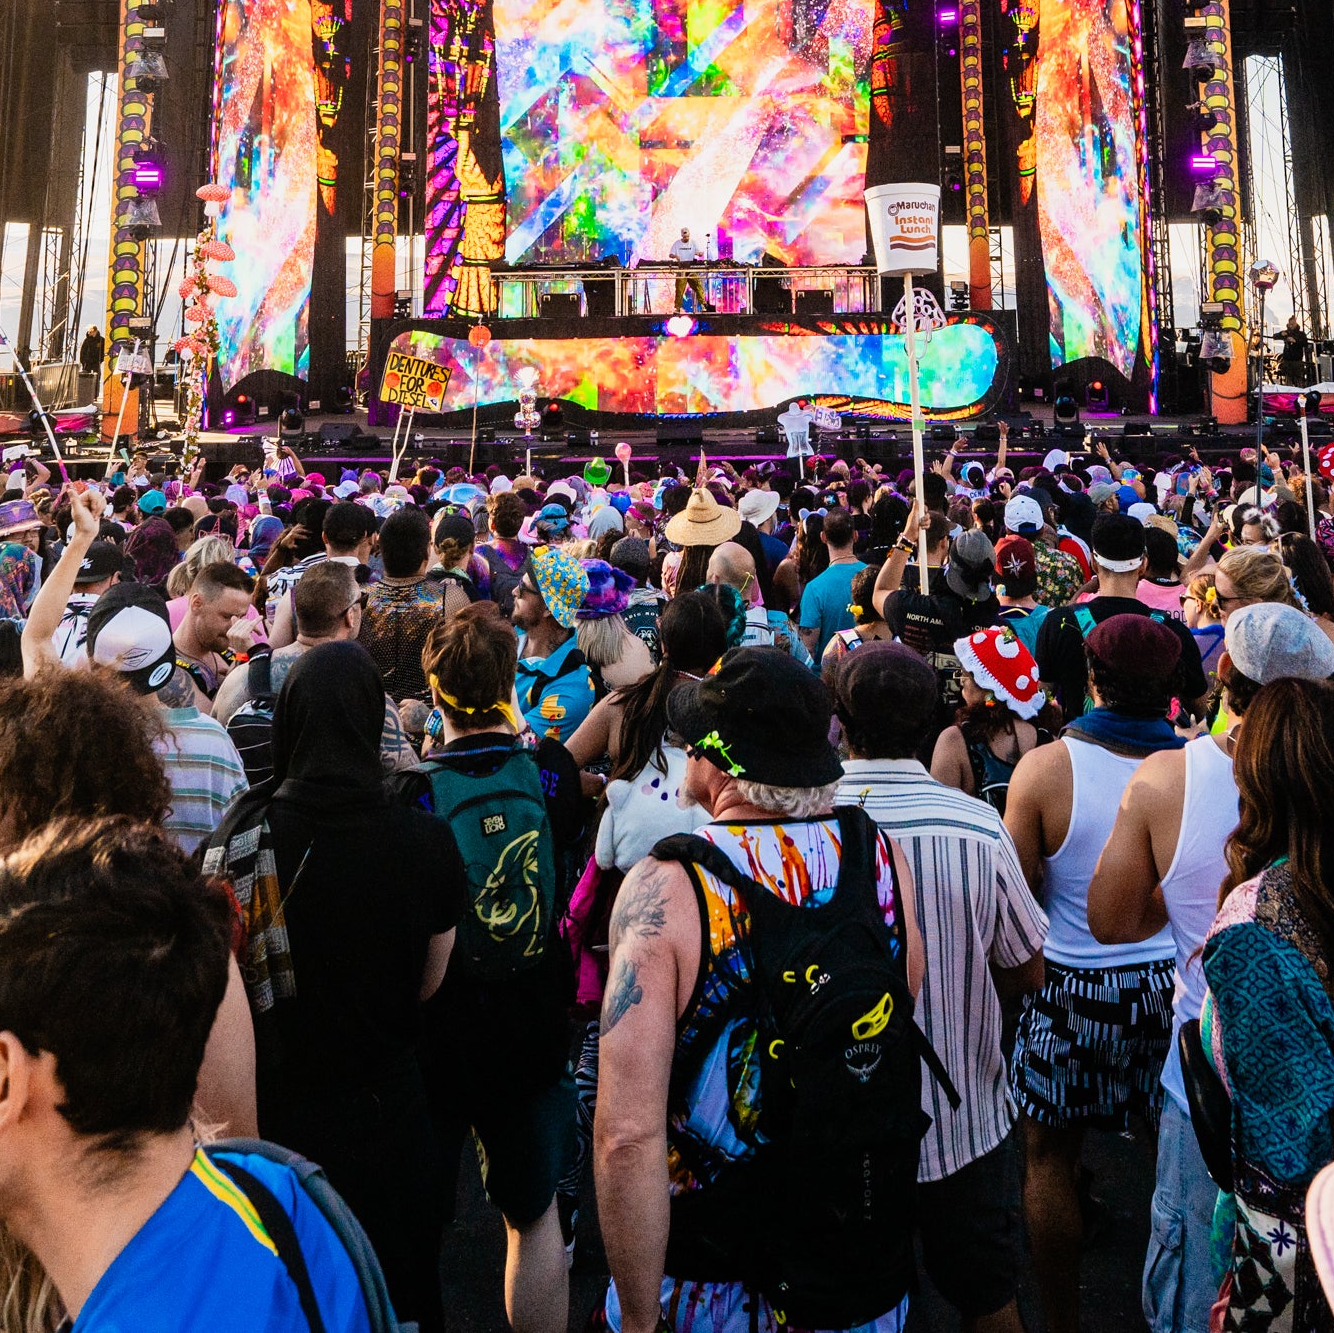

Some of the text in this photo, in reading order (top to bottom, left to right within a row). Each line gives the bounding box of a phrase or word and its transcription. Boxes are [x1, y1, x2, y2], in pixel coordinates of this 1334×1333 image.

[896, 200, 936, 213] Maruchan
[894, 216, 934, 226] Instant
[899, 225, 932, 234] Lunch
[389, 353, 450, 384] DENTURES
[399, 374, 427, 394] FOR
[388, 387, 432, 410] DIESEL
[906, 613, 930, 624] NORTH
